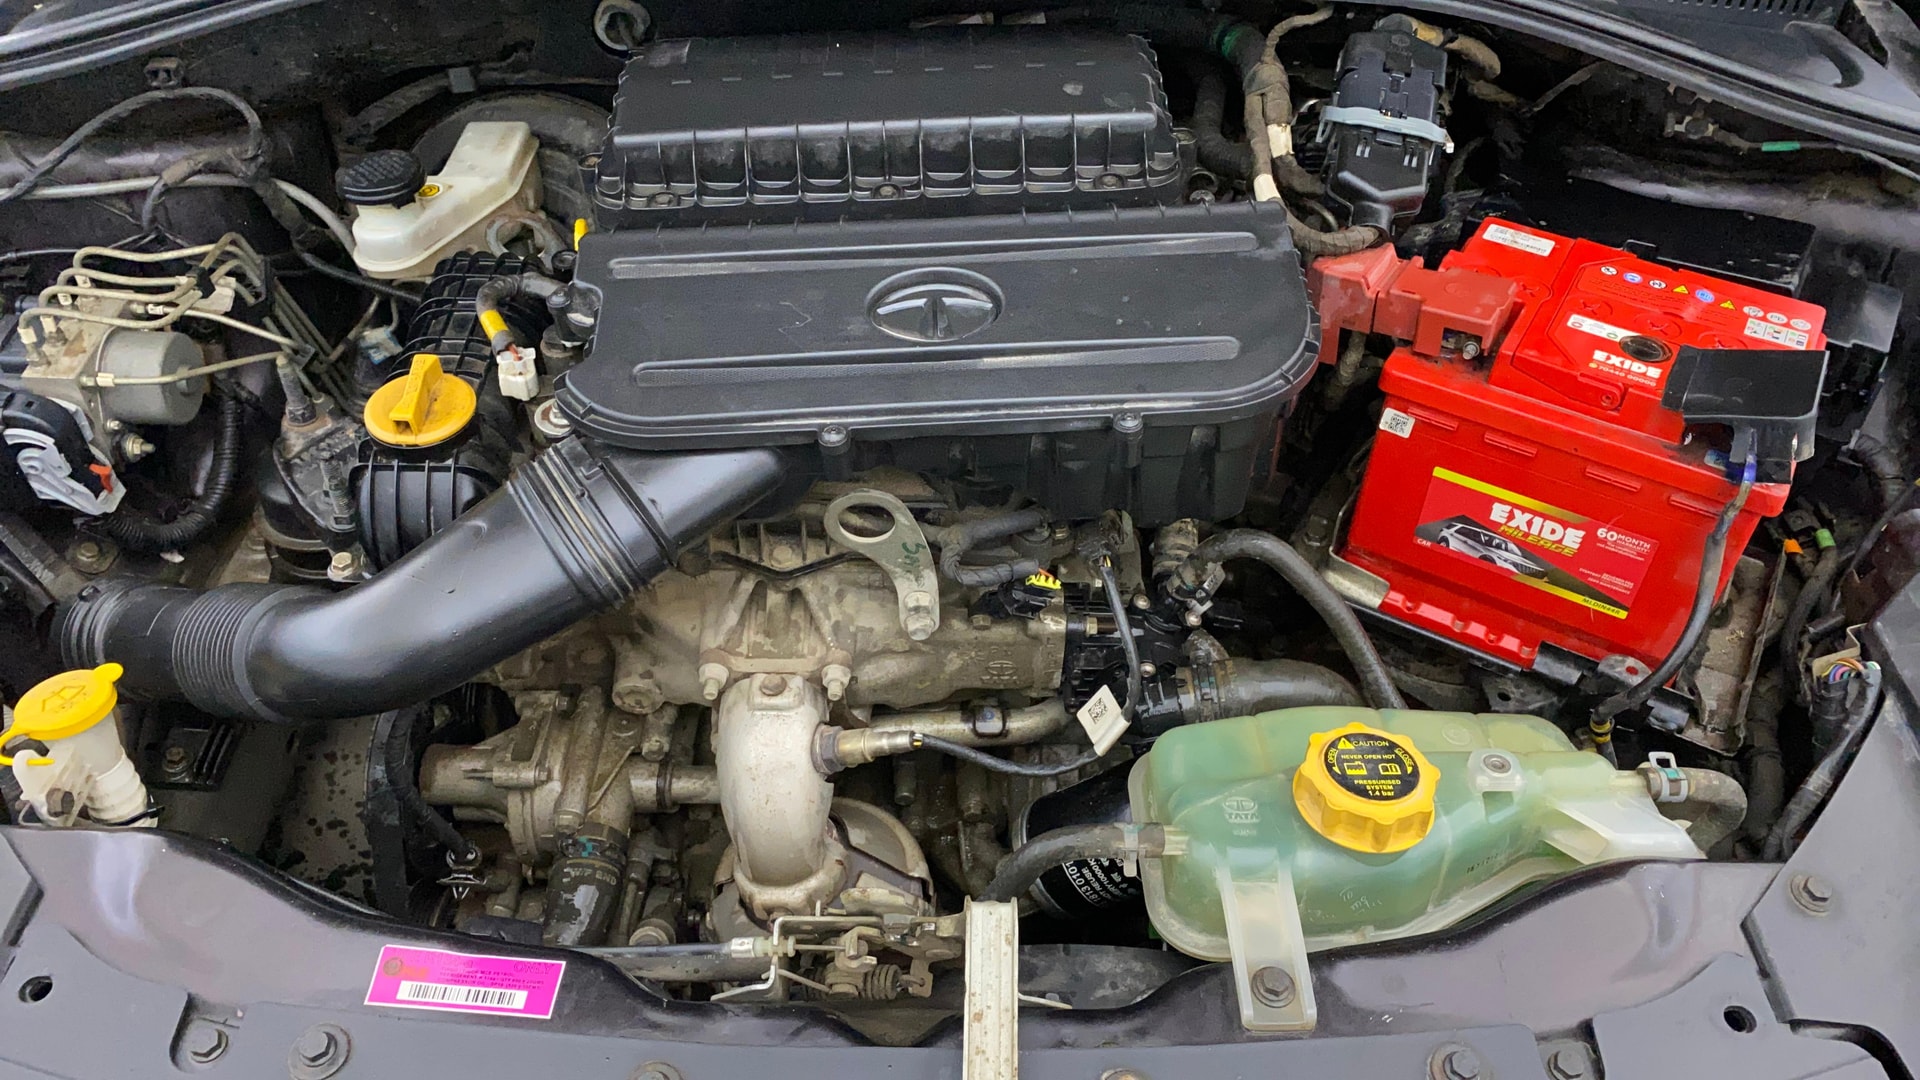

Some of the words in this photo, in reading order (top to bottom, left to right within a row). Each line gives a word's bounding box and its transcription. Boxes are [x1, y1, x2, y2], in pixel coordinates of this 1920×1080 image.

[1592, 350, 1663, 379] EXIDE
[1489, 502, 1586, 549] EXIDE
[1417, 538, 1431, 547] CAR
[1497, 524, 1578, 558] MILEAGE
[1596, 528, 1618, 541] 60
[1617, 534, 1651, 549] MONTH
[1582, 597, 1620, 615] MLDIN44R
[1328, 747, 1338, 763] OPEN
[1396, 747, 1414, 767] CLOSE
[1223, 812, 1260, 823] TATA
